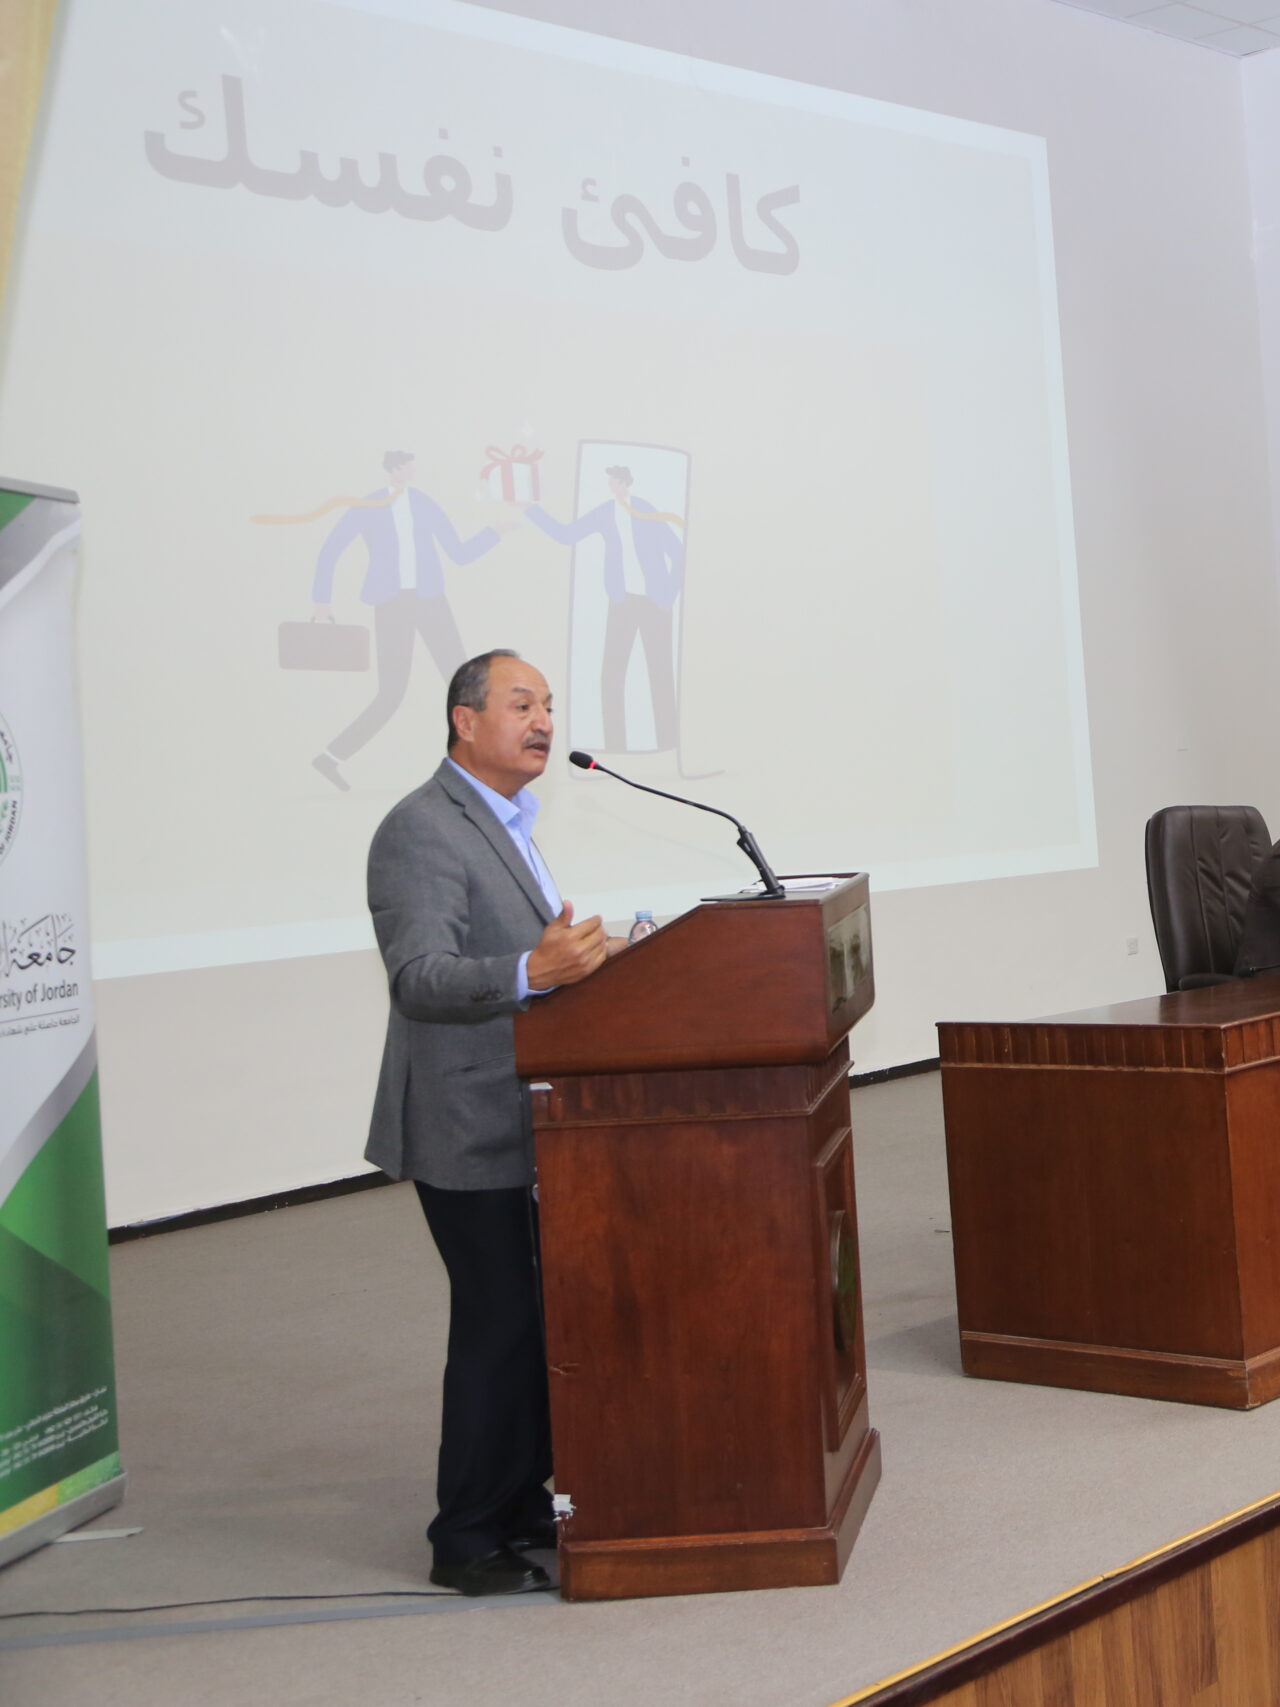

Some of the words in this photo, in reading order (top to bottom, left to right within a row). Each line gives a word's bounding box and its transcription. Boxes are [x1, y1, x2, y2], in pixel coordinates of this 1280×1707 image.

[144, 74, 513, 233] نفسك
[561, 156, 800, 276] كافئ
[0, 988, 22, 1011] rsity
[25, 983, 38, 1004] of
[41, 979, 79, 1002] Jordan
